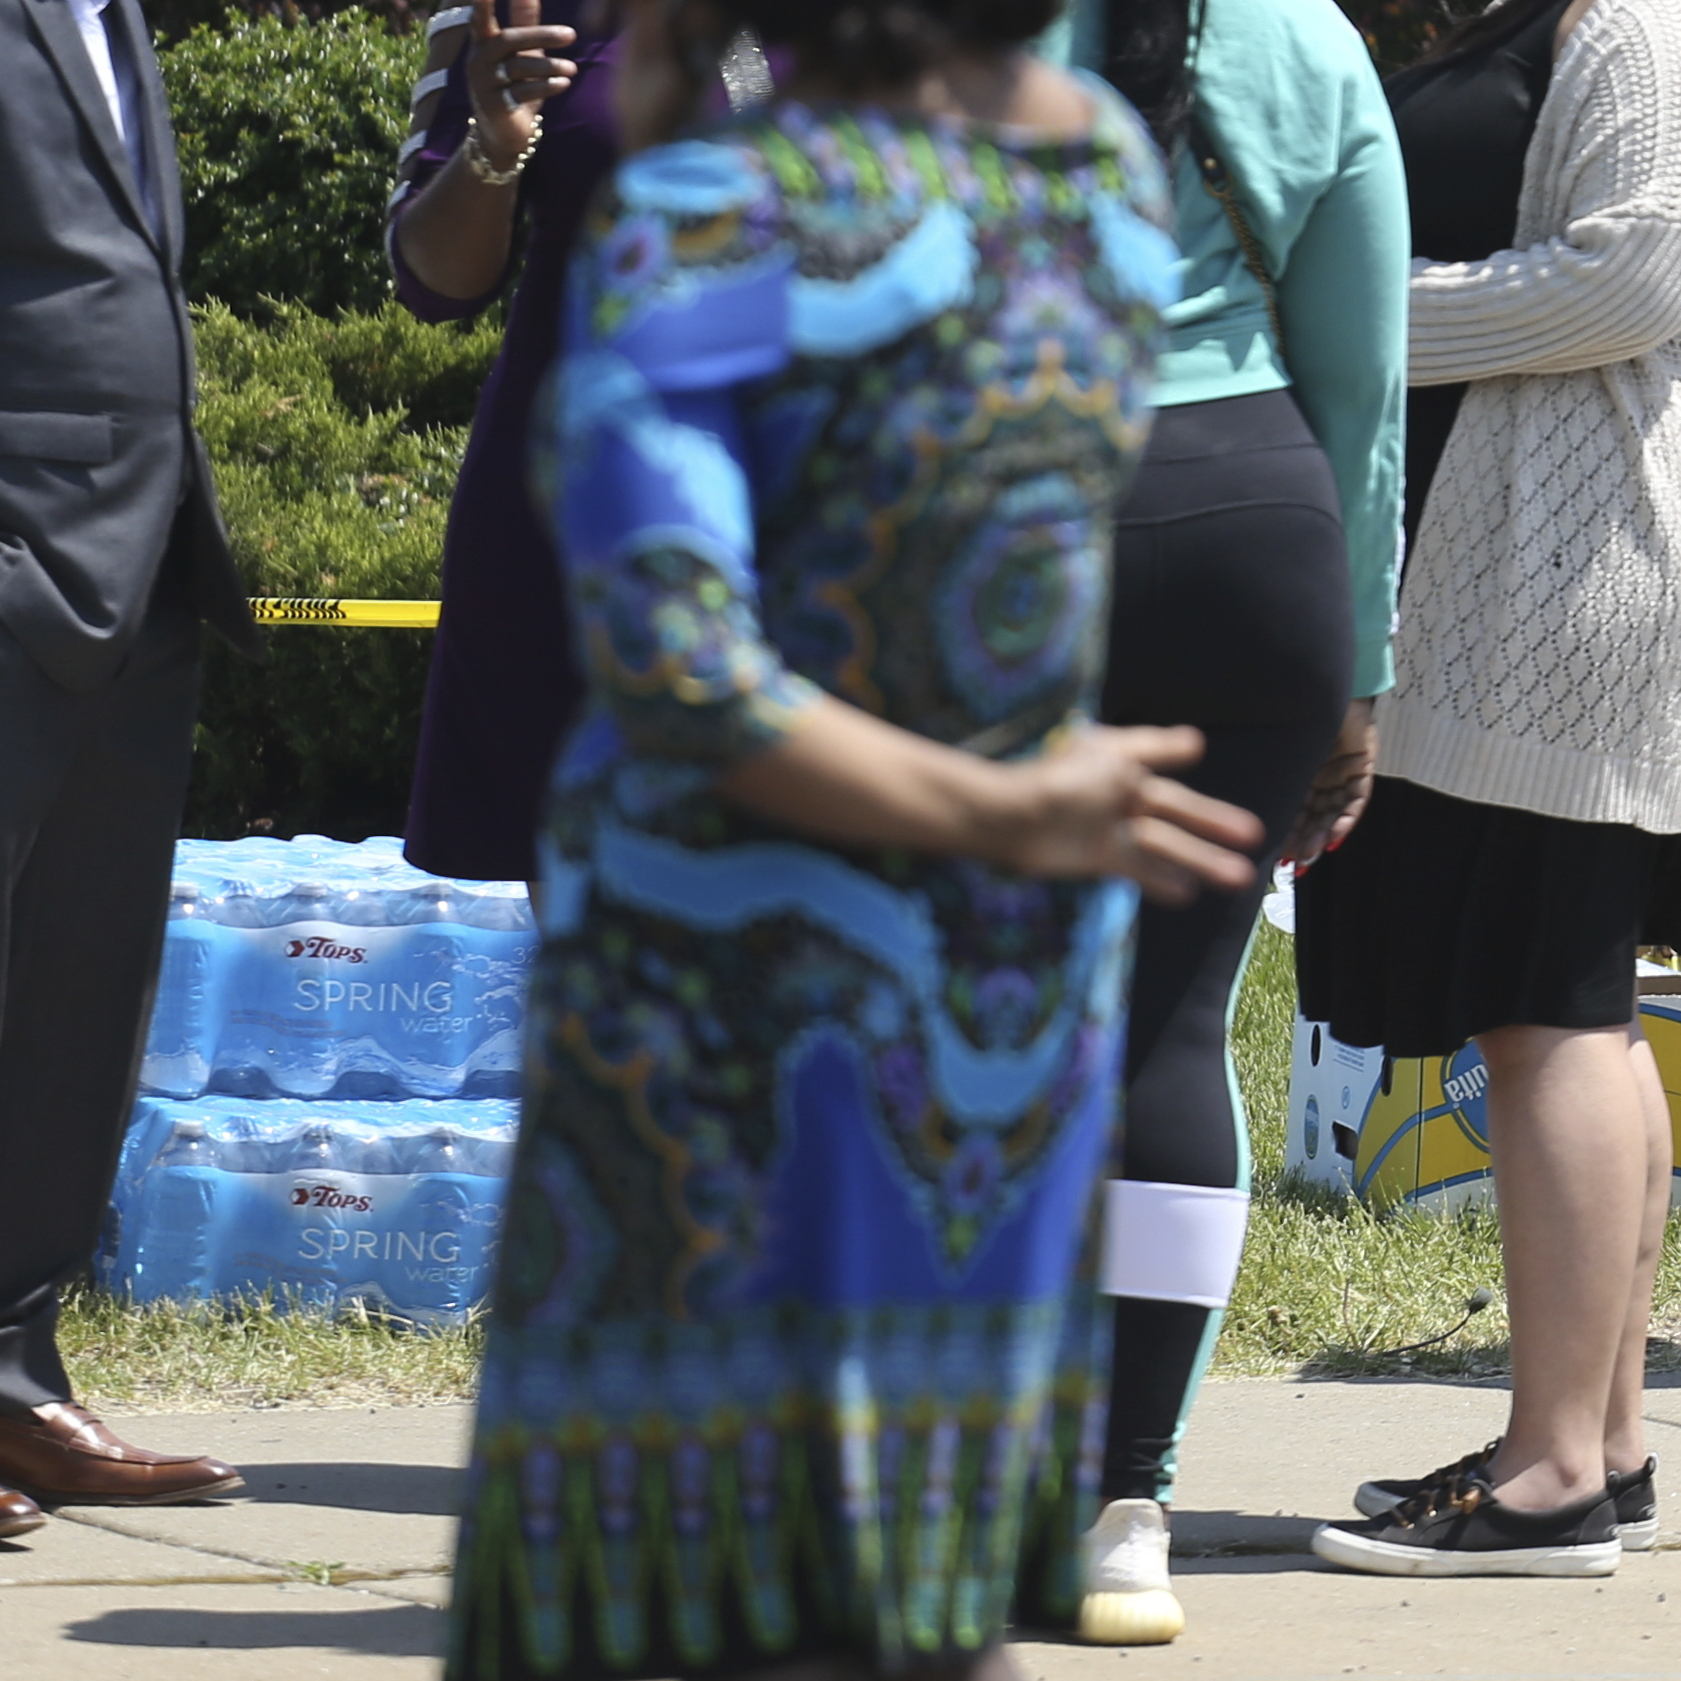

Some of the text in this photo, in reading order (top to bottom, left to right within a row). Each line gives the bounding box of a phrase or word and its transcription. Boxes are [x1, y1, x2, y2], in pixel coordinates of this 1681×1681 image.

[306, 936, 367, 964] TOPS
[293, 978, 451, 1012] SPRING
[400, 1015, 473, 1033] water
[1443, 1063, 1490, 1101] uita
[312, 1185, 372, 1212] TOPS
[297, 1228, 460, 1263] SPRING
[404, 1265, 479, 1283] water
